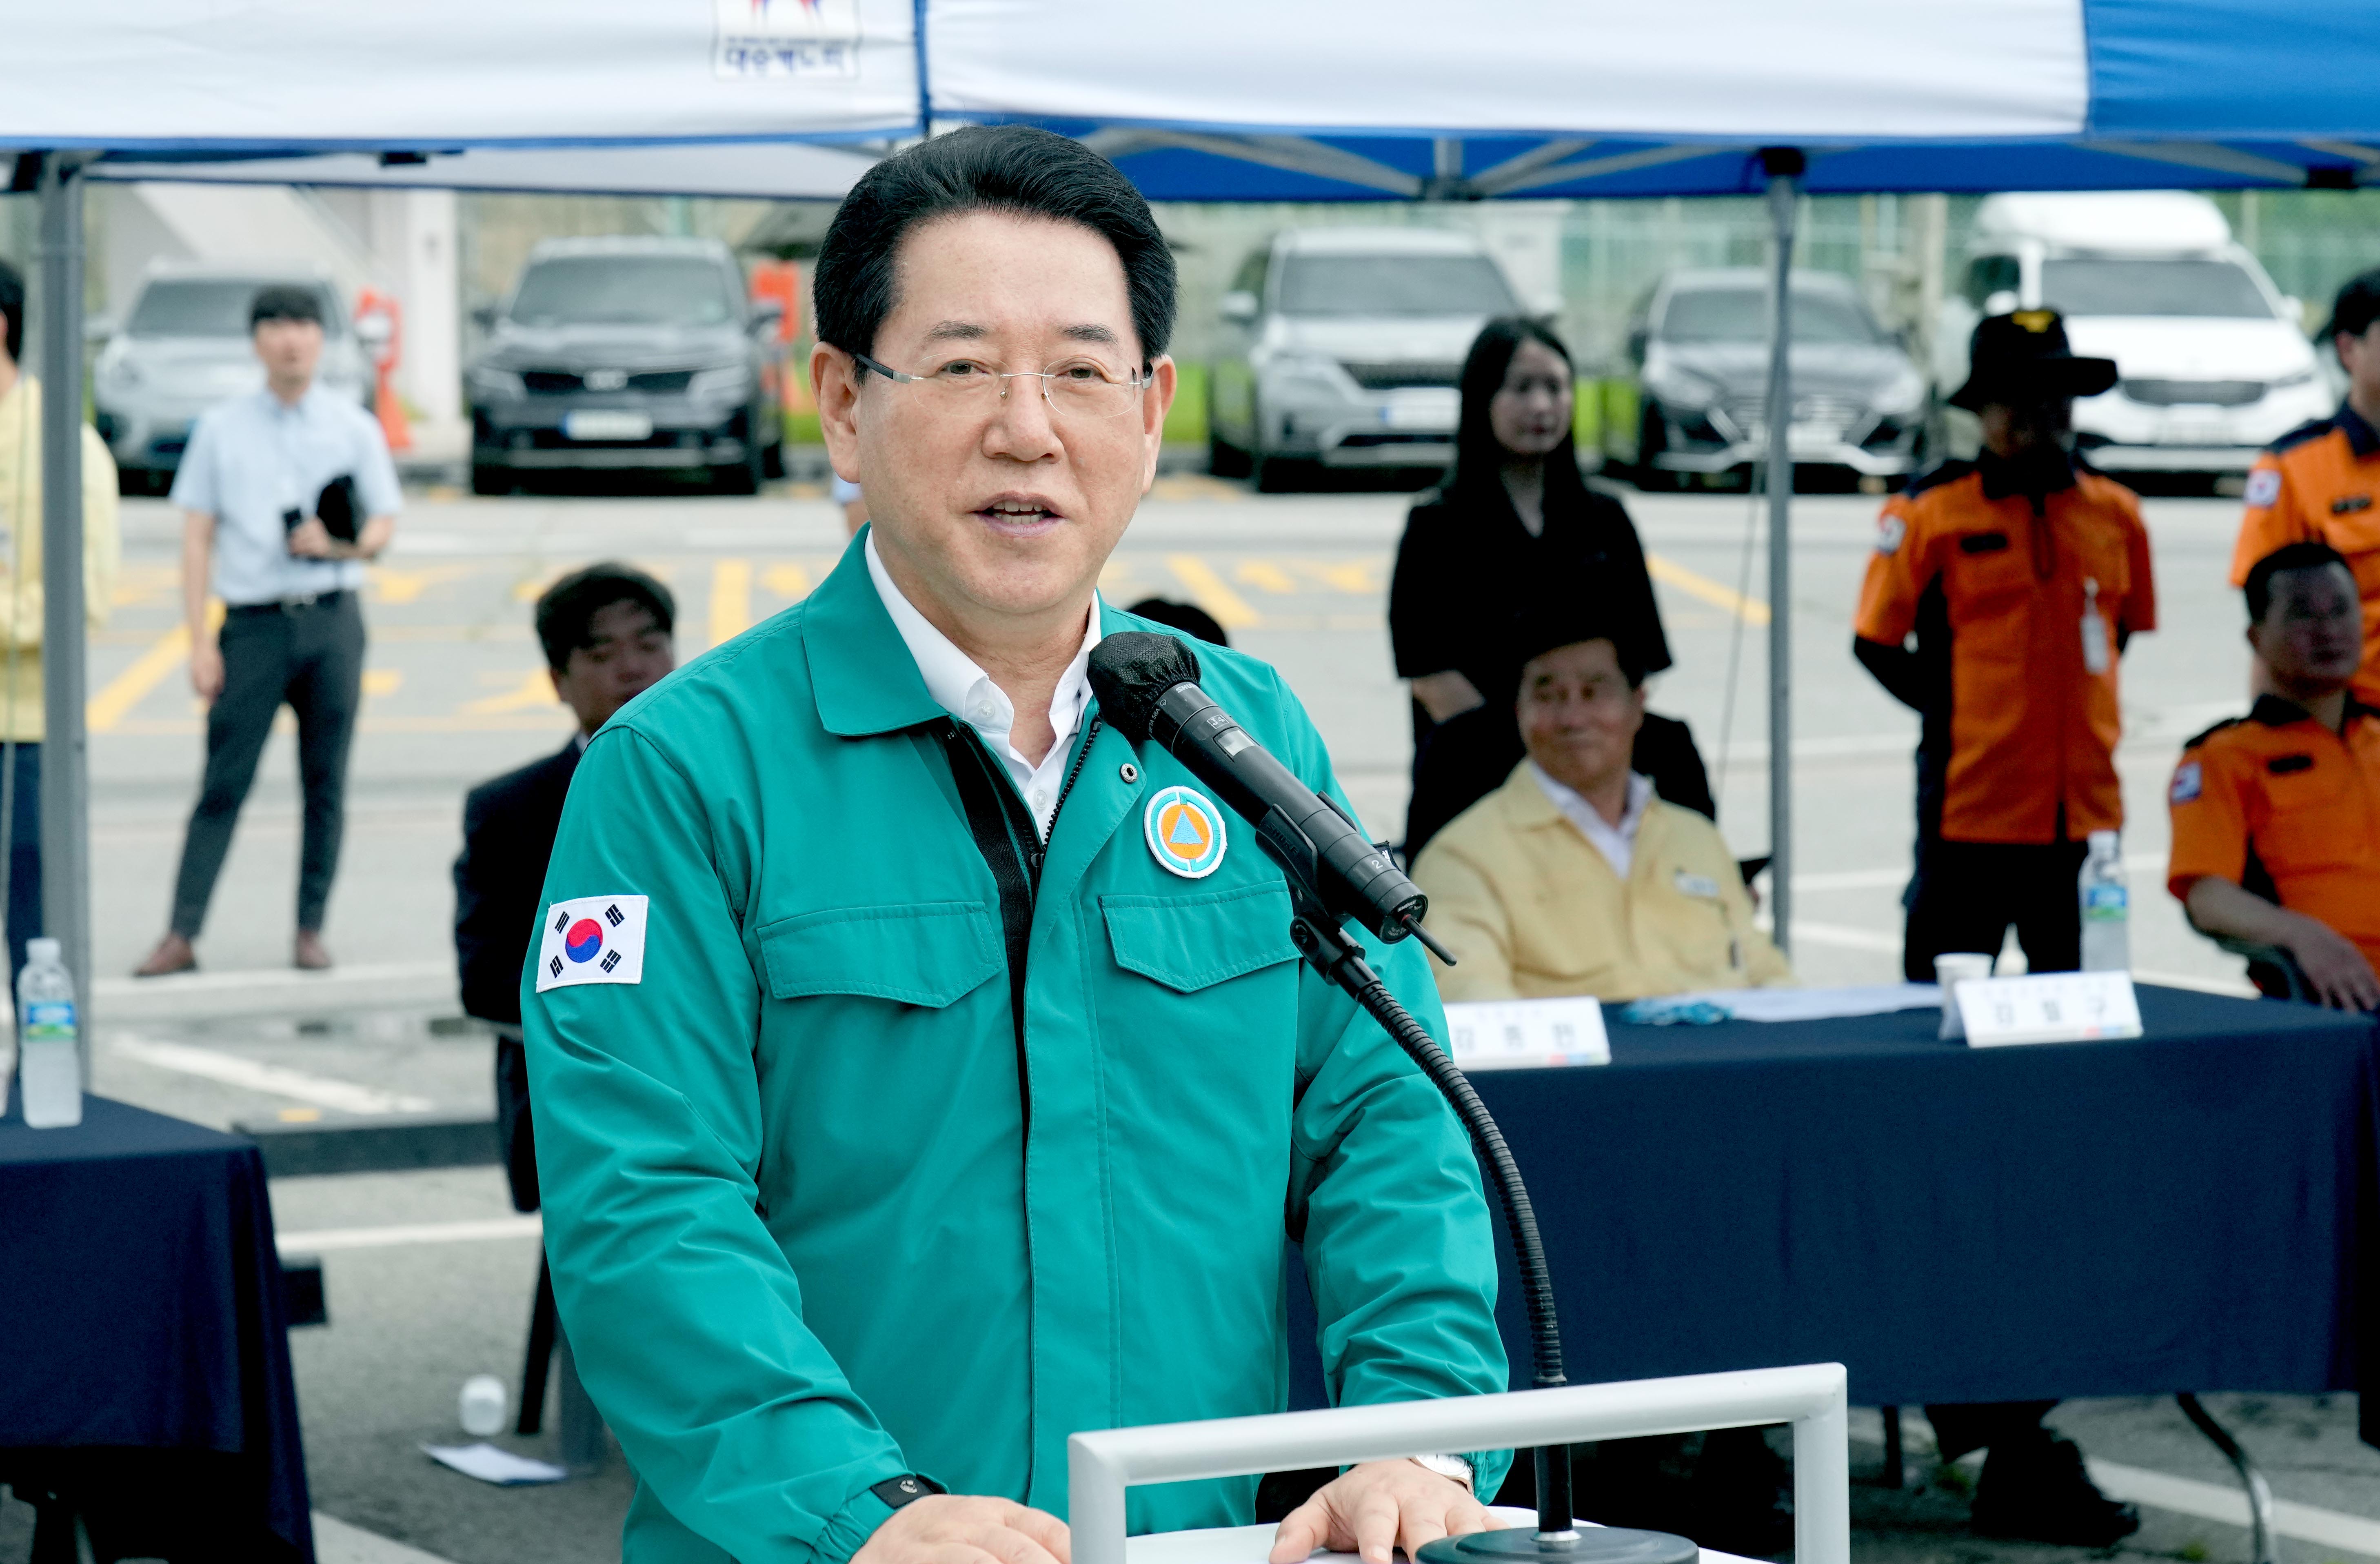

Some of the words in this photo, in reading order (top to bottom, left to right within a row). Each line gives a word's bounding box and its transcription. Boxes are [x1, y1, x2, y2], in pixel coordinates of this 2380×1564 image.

[1152, 708, 1161, 720] 58A
[1212, 715, 1226, 726] J4
[1372, 860, 1383, 869] 2
